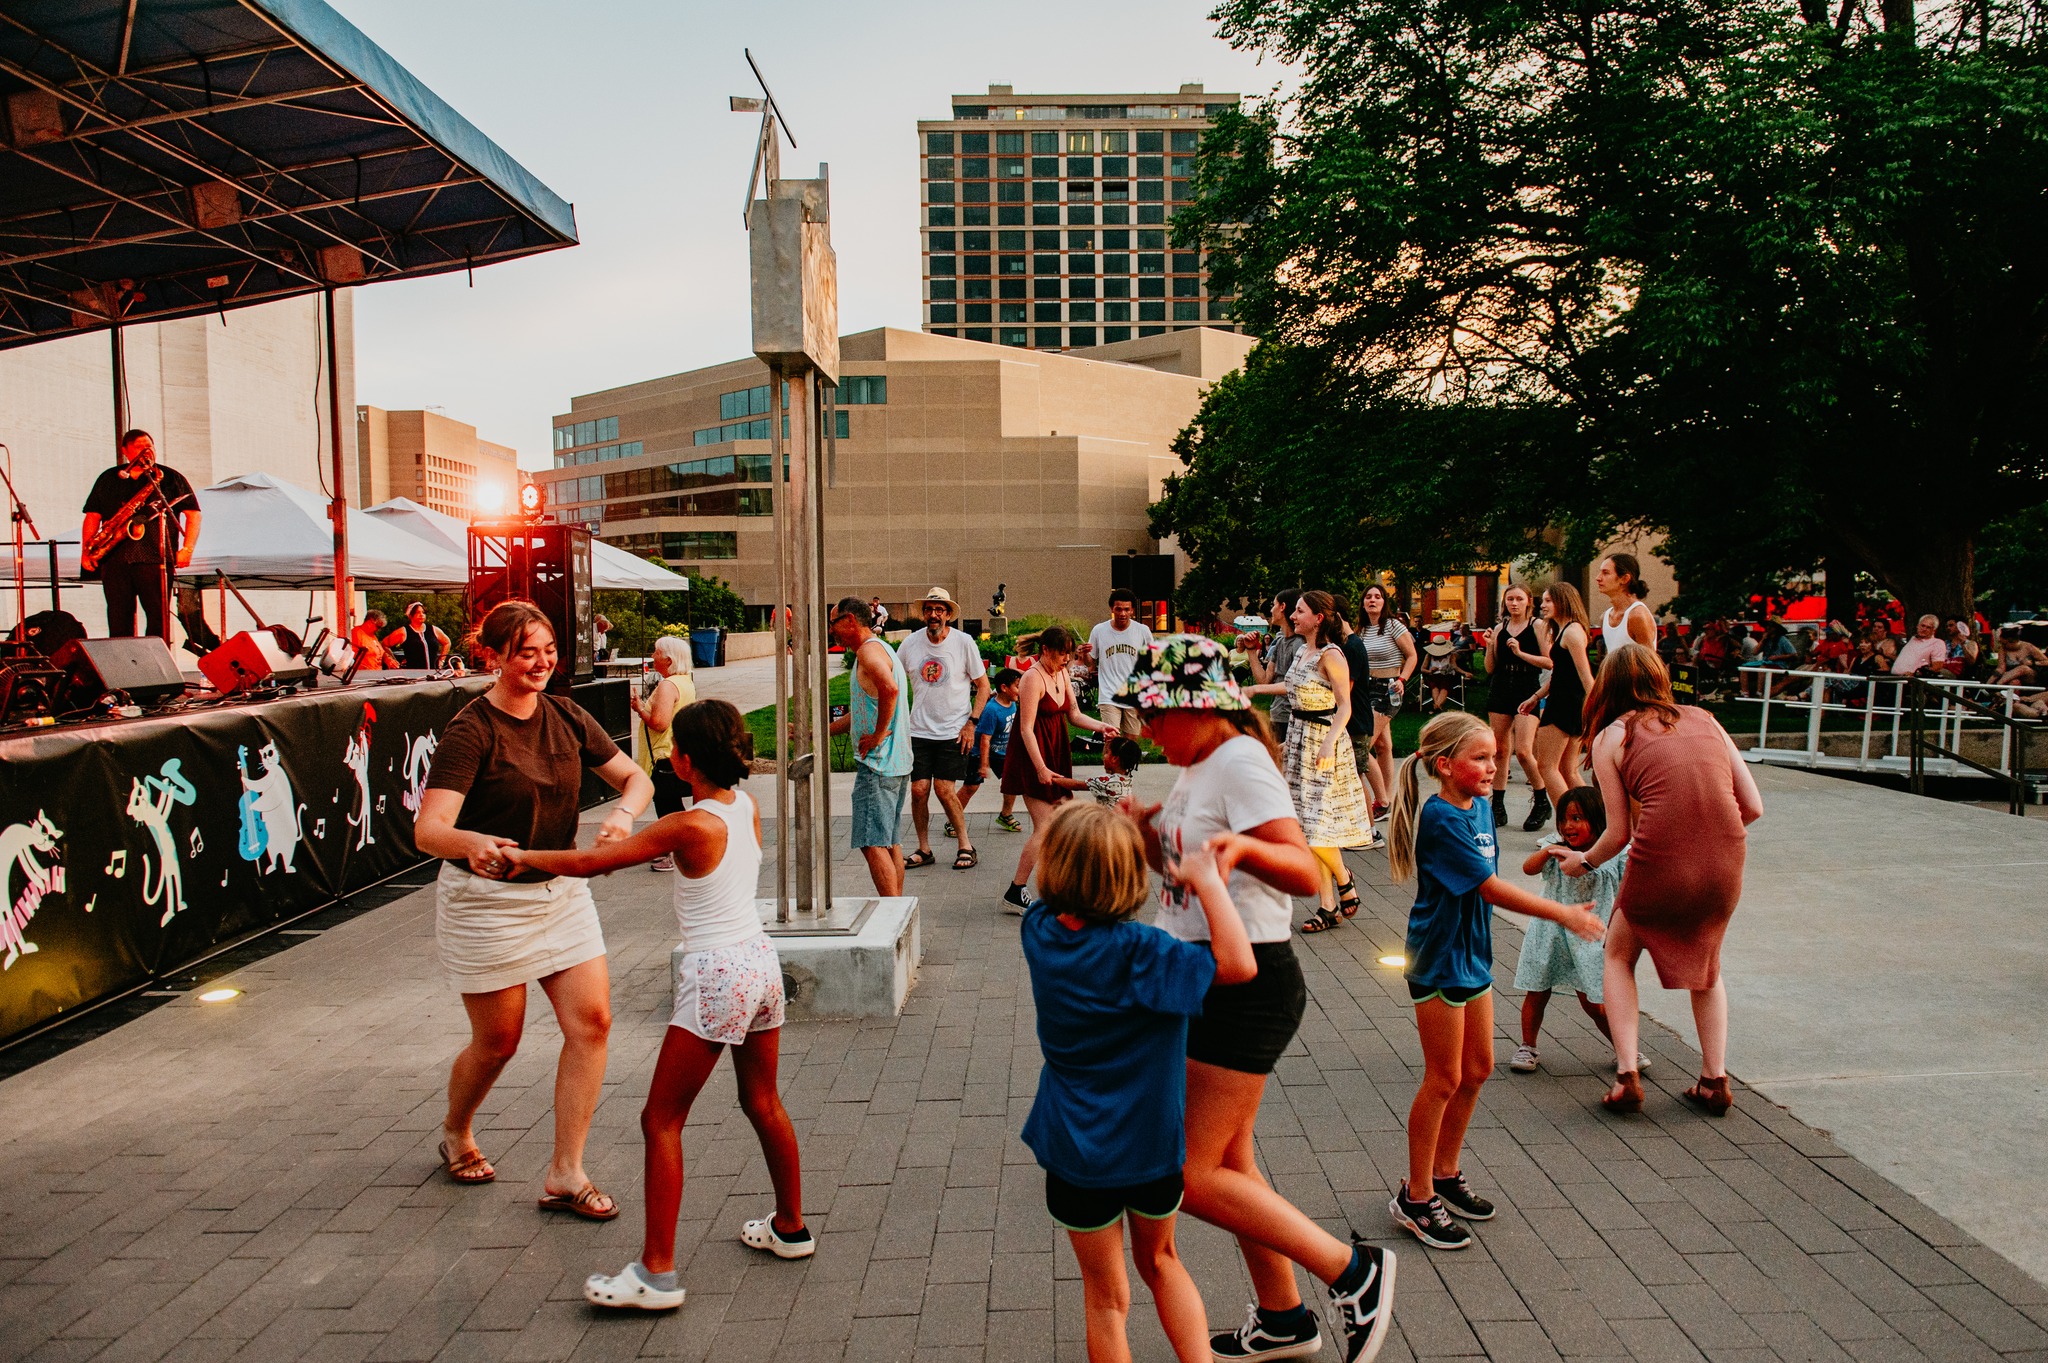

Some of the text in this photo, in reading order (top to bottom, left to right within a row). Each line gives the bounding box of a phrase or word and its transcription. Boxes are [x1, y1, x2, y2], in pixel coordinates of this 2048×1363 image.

[1105, 645, 1115, 658] YOU
[1679, 670, 1689, 680] VIP
[1672, 681, 1694, 694] SEATING
